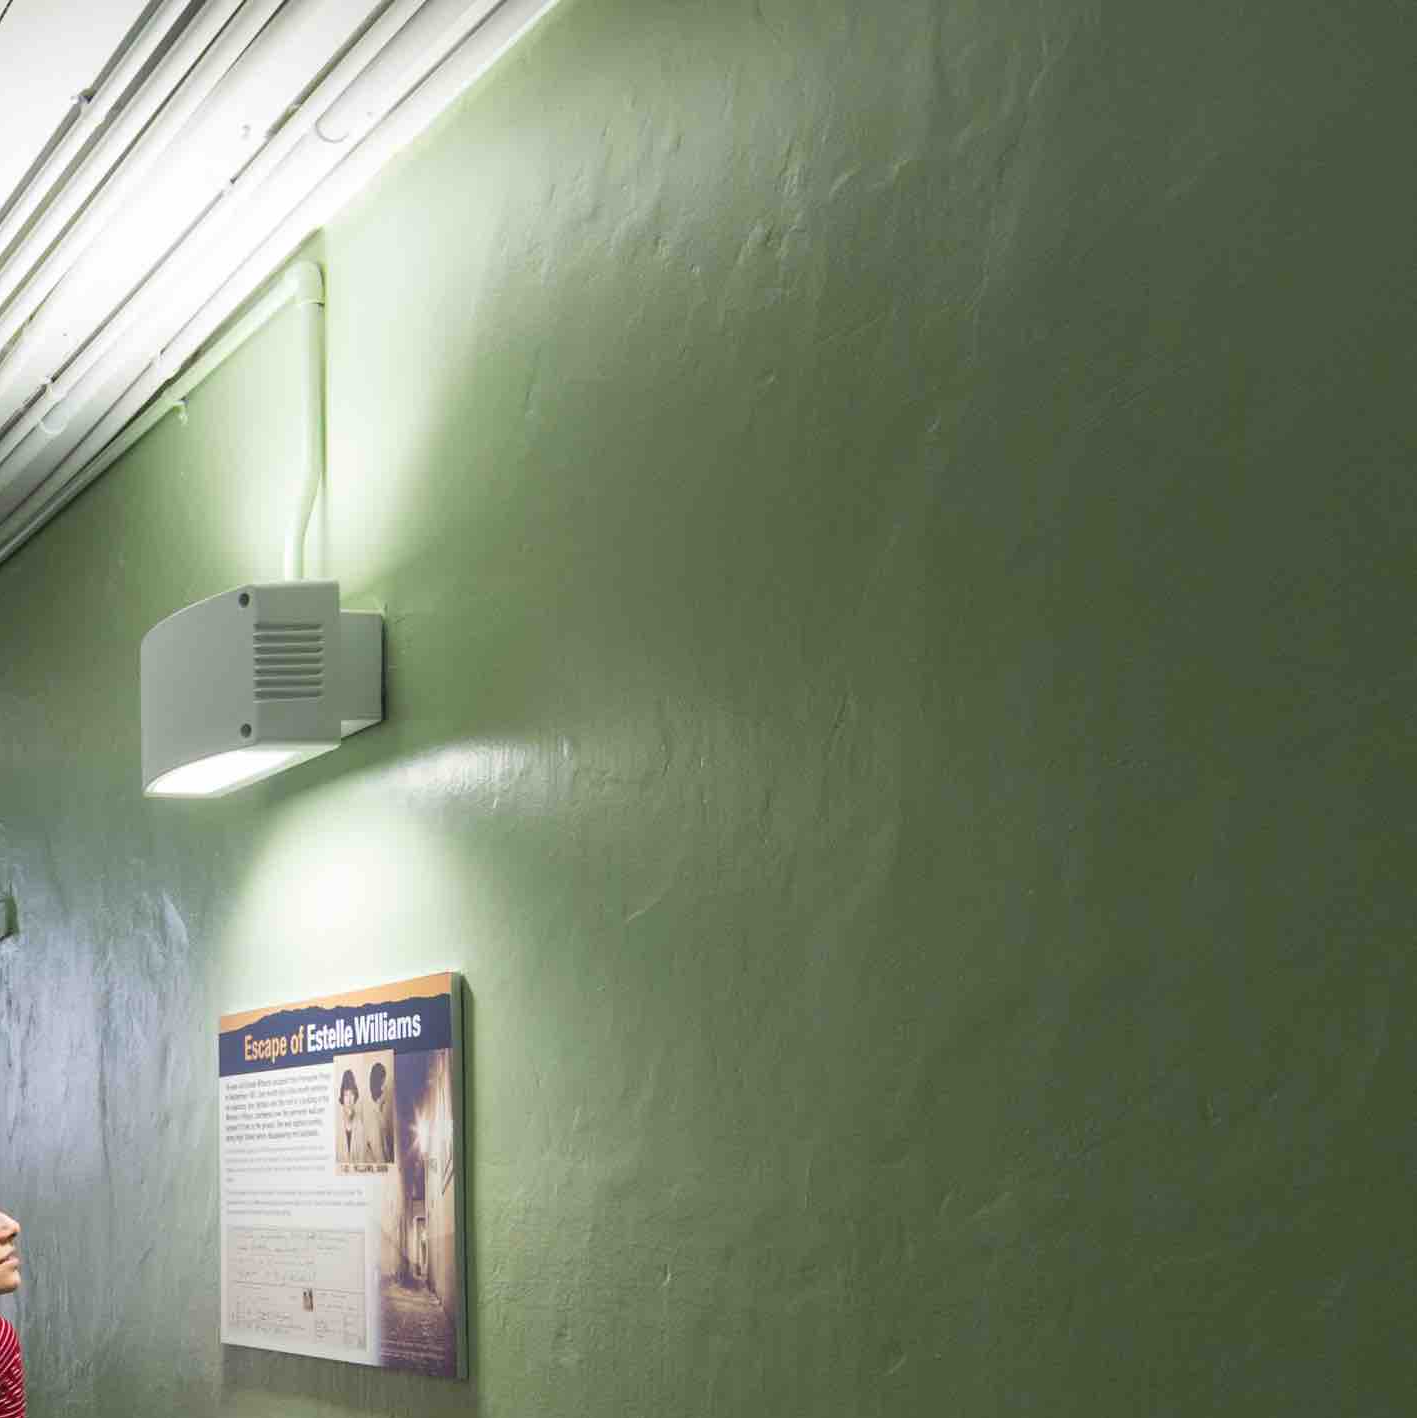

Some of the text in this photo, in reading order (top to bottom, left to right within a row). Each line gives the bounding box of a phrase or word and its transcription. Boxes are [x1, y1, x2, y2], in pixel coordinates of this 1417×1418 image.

[244, 1012, 421, 1062] Escape of Estelle Williams
